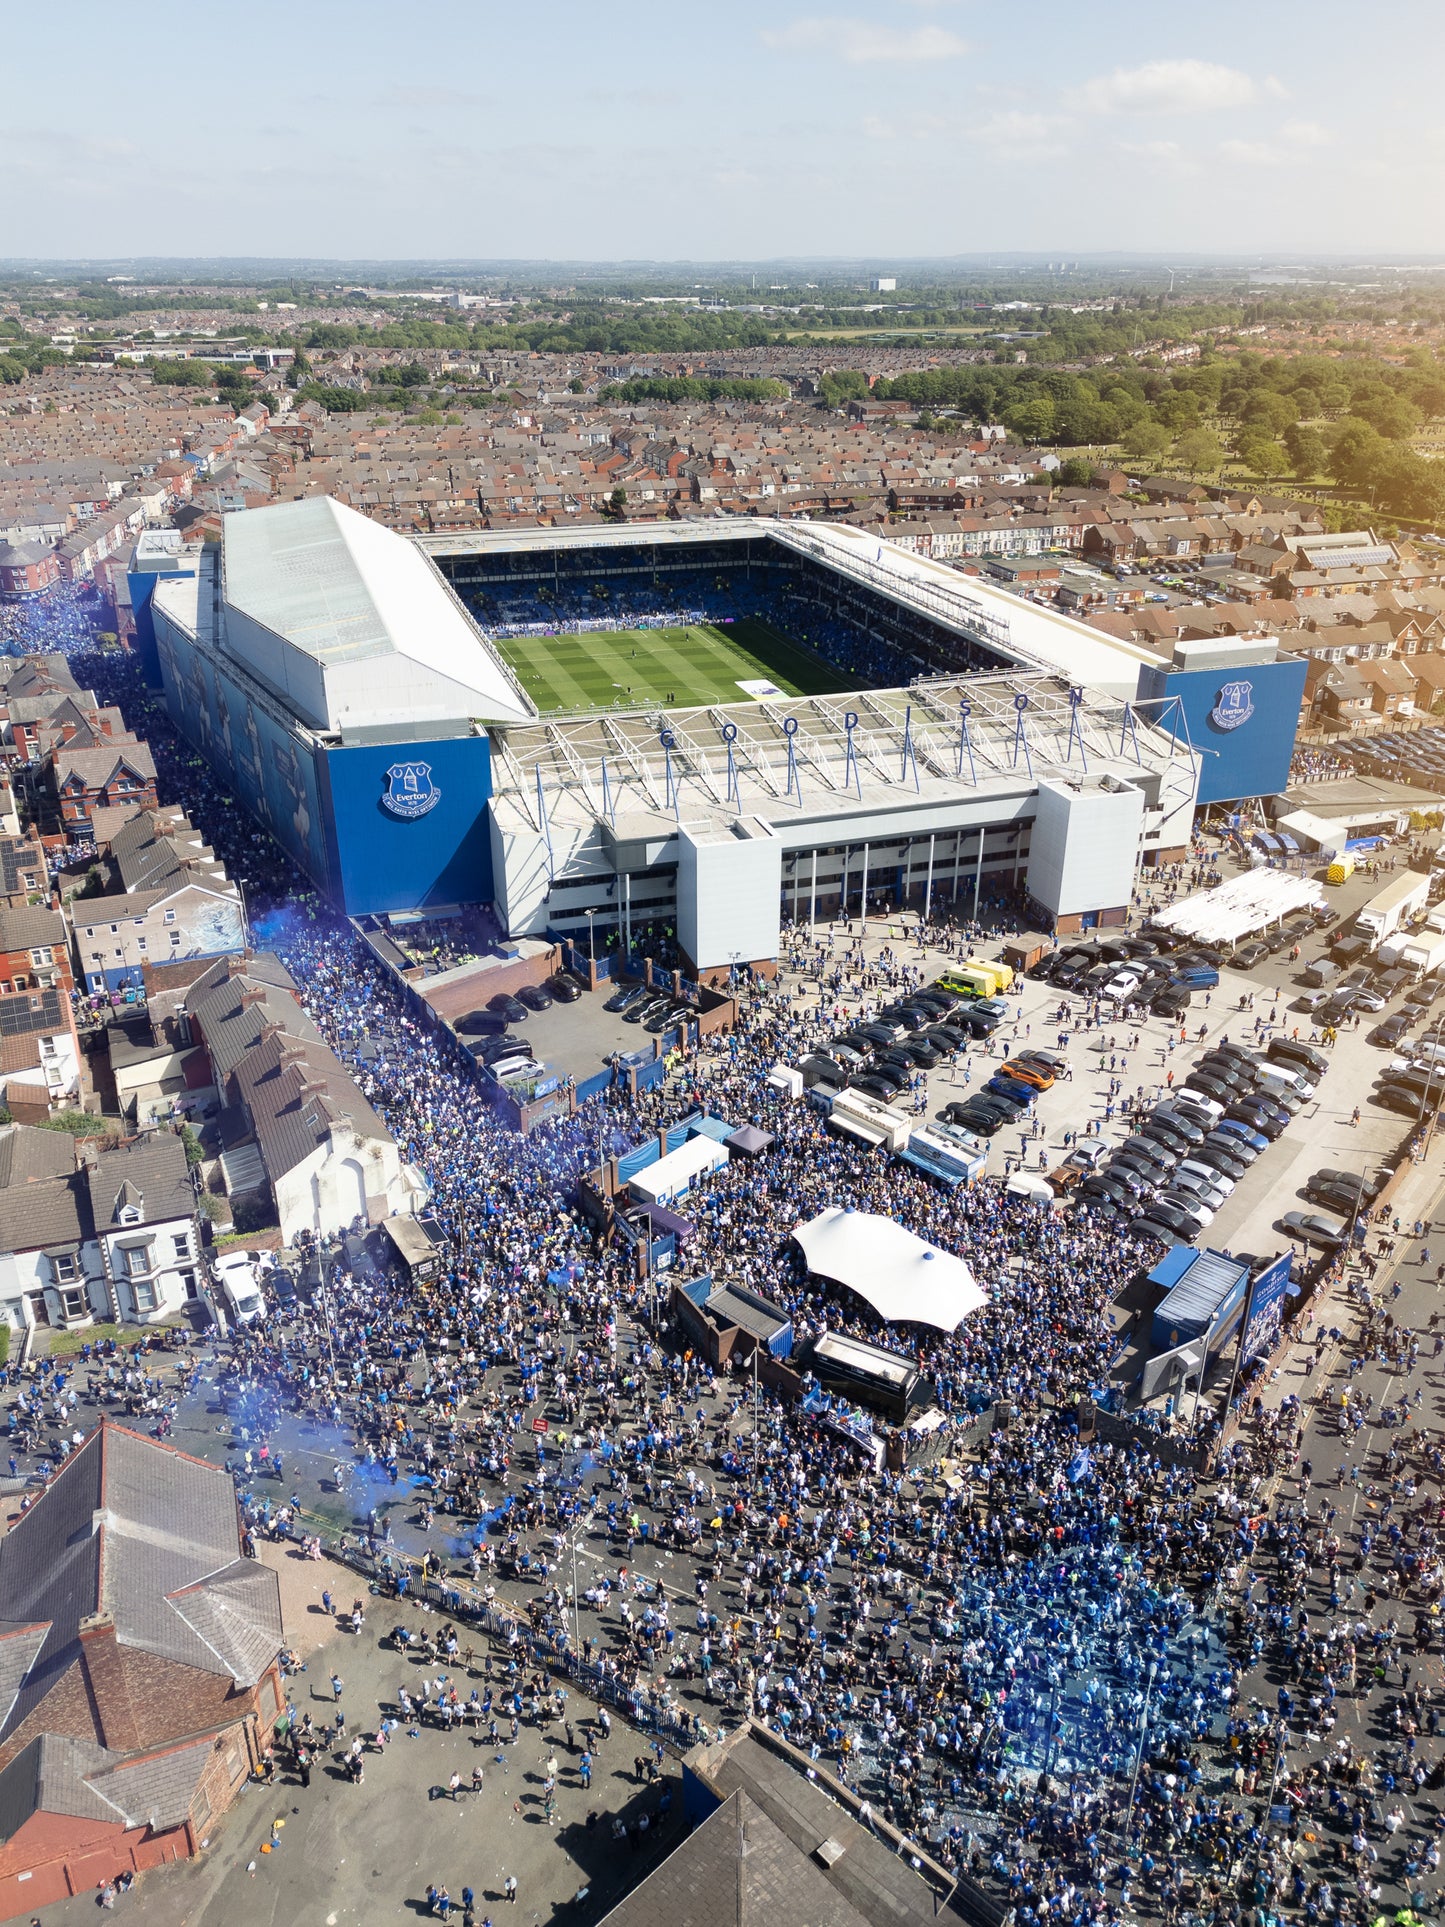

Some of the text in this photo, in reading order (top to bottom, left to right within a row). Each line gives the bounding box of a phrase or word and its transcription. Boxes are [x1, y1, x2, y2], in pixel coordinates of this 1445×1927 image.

[660, 685, 1083, 748] GOODISON
[1221, 708, 1245, 716] Everton
[396, 793, 428, 802] Everton
